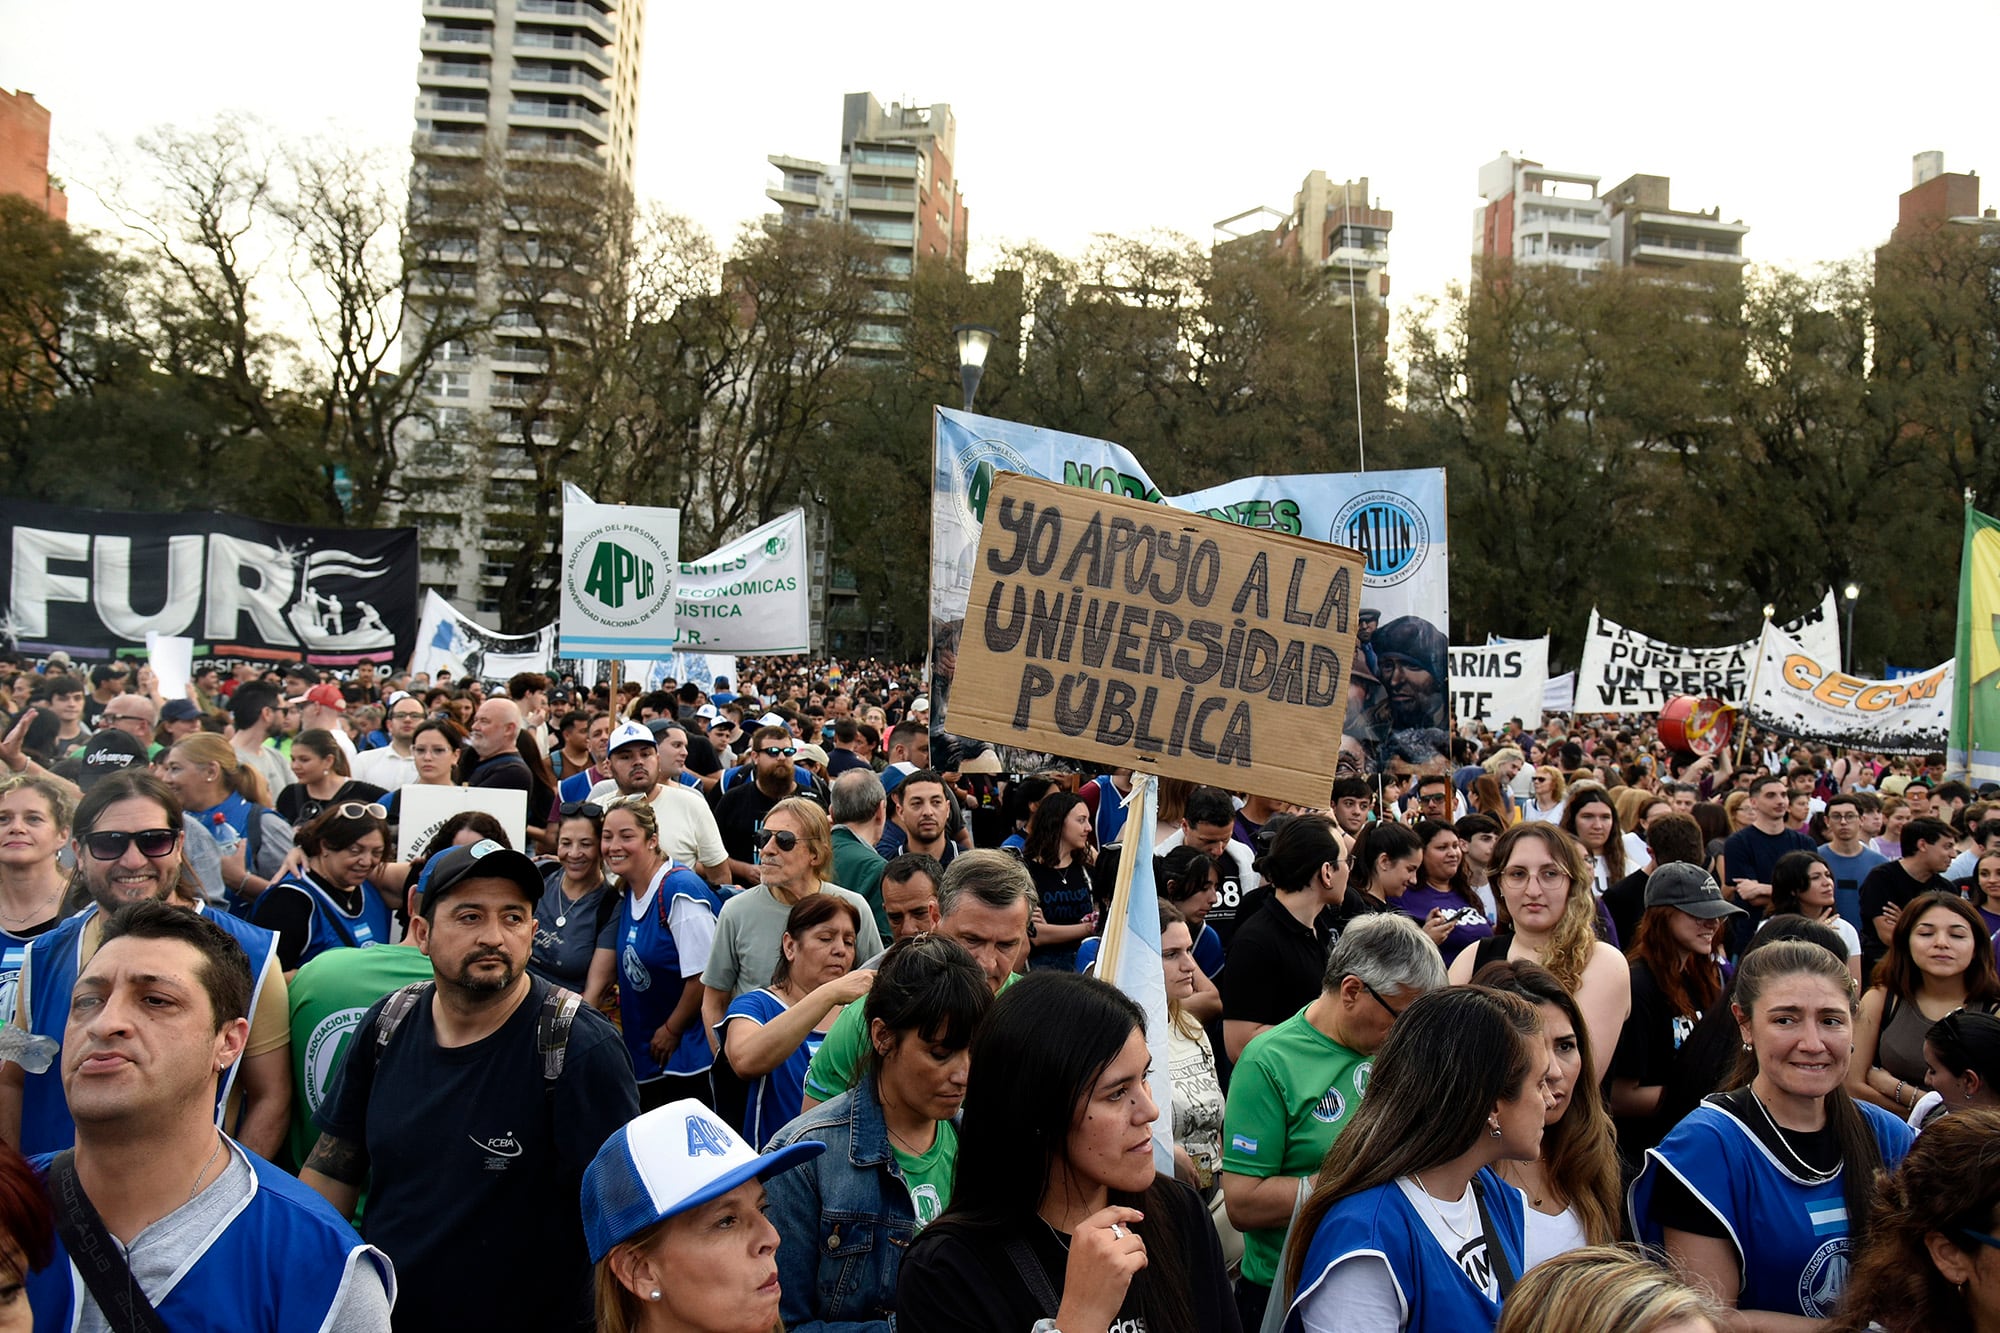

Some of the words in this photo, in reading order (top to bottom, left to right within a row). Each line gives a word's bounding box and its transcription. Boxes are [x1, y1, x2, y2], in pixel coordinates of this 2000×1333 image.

[604, 523, 621, 532] DEL
[623, 523, 662, 551] PERSONAL
[1349, 507, 1410, 572] FATUN
[660, 549, 671, 562] DE
[664, 563, 673, 575] LA
[988, 495, 1063, 576] YO
[1060, 517, 1220, 607] APOYO
[1231, 551, 1269, 619] A
[1284, 557, 1350, 633] LA
[10, 525, 299, 647] FUR
[584, 541, 655, 609] APUR
[599, 617, 641, 628] NACIONAL
[639, 613, 651, 622] DE
[1449, 651, 1522, 678] ARIAS
[1603, 664, 1644, 688] UN
[1782, 653, 1949, 712] CECM
[1012, 663, 1252, 769] PÚBLICA
[411, 836, 426, 852] DEL
[308, 1013, 352, 1063] ASOCIACION
[1802, 1250, 1826, 1290] ASOCIACION
[1825, 1242, 1839, 1254] DEL
